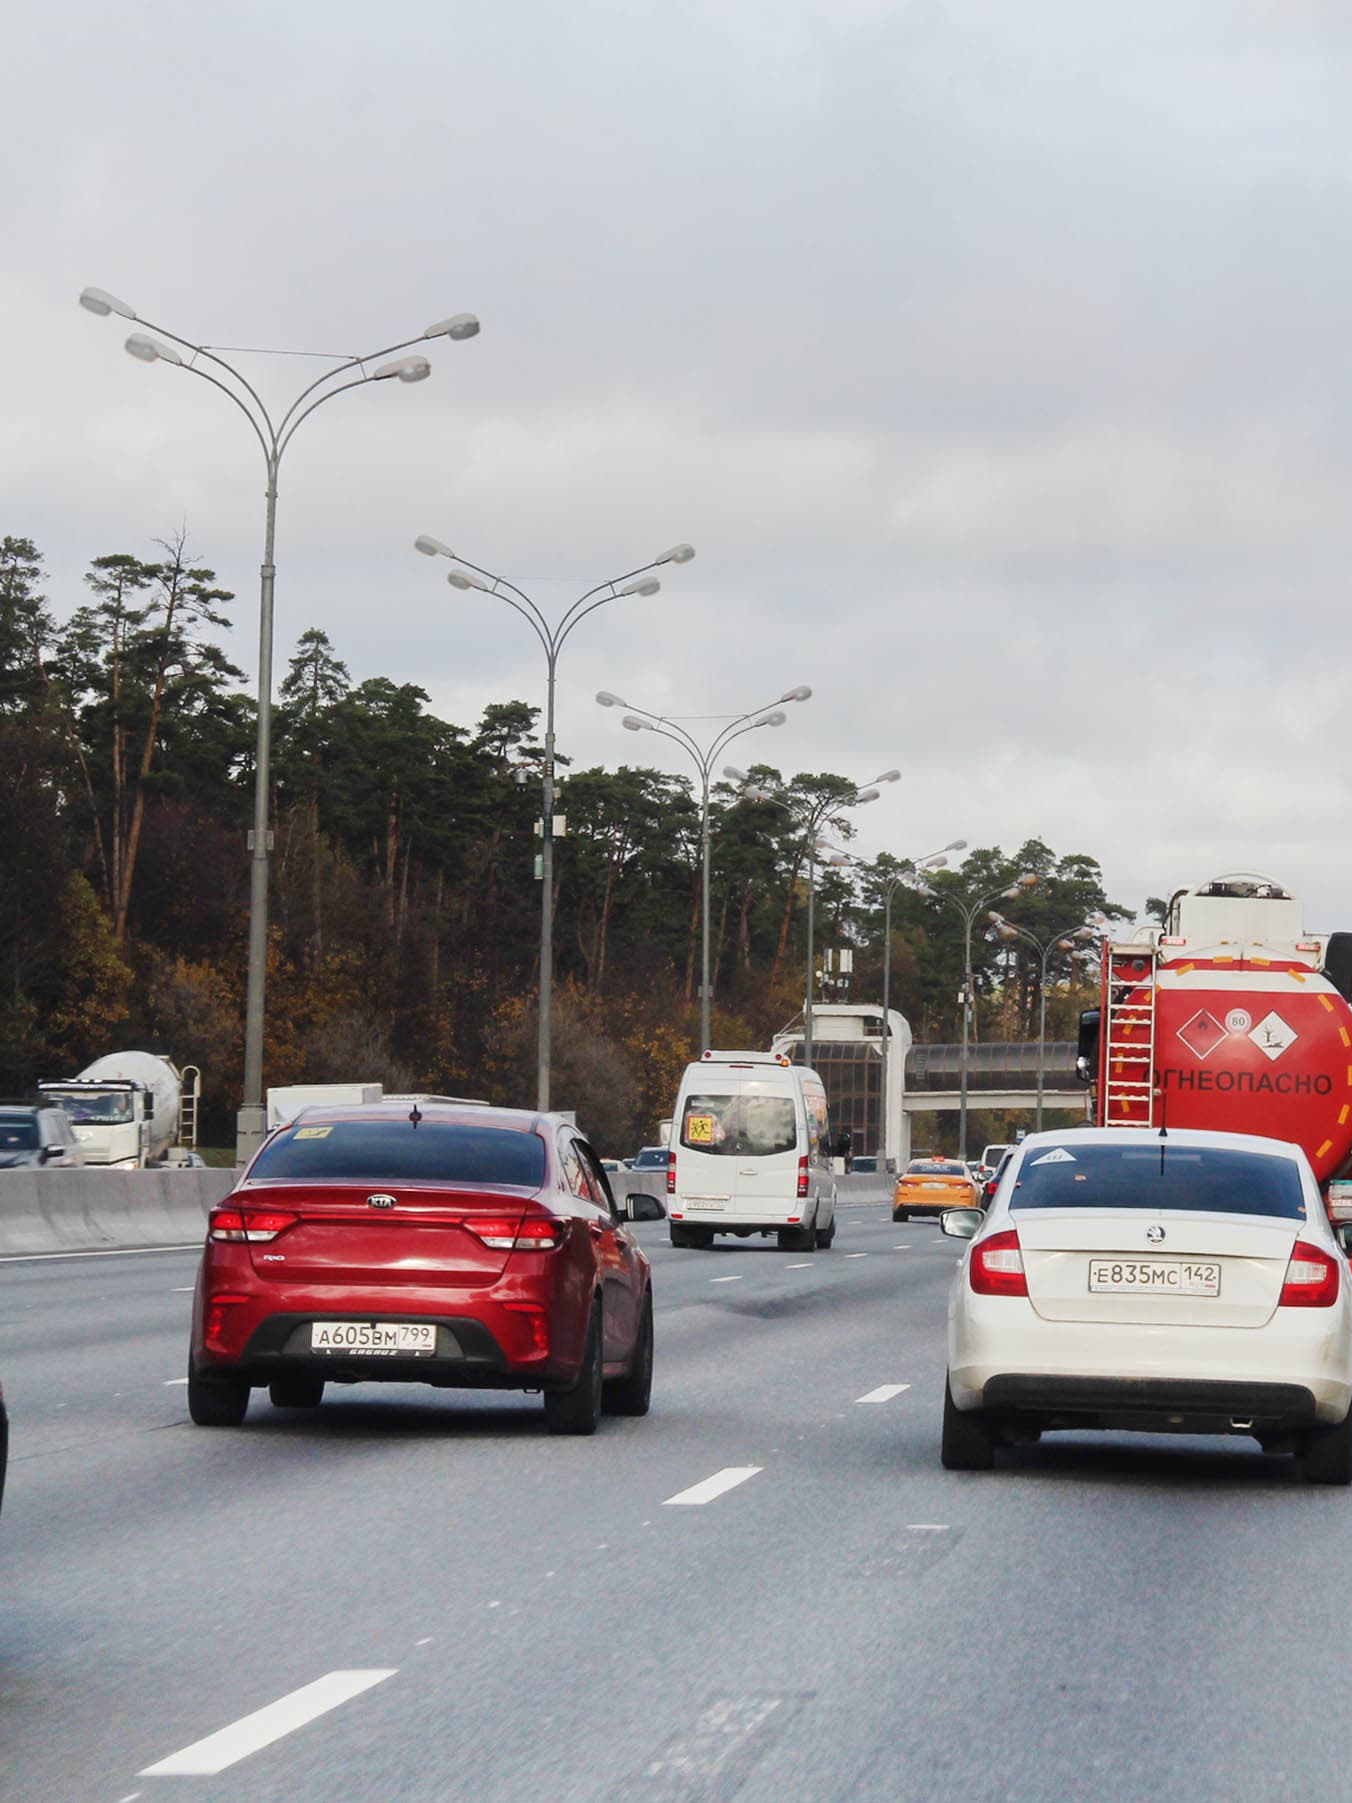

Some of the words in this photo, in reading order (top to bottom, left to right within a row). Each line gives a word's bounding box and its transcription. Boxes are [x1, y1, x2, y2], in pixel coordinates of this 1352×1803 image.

[1232, 1017, 1245, 1026] 80
[1142, 1068, 1332, 1096] ОГНЕОПАСНО
[371, 1196, 392, 1207] KIA
